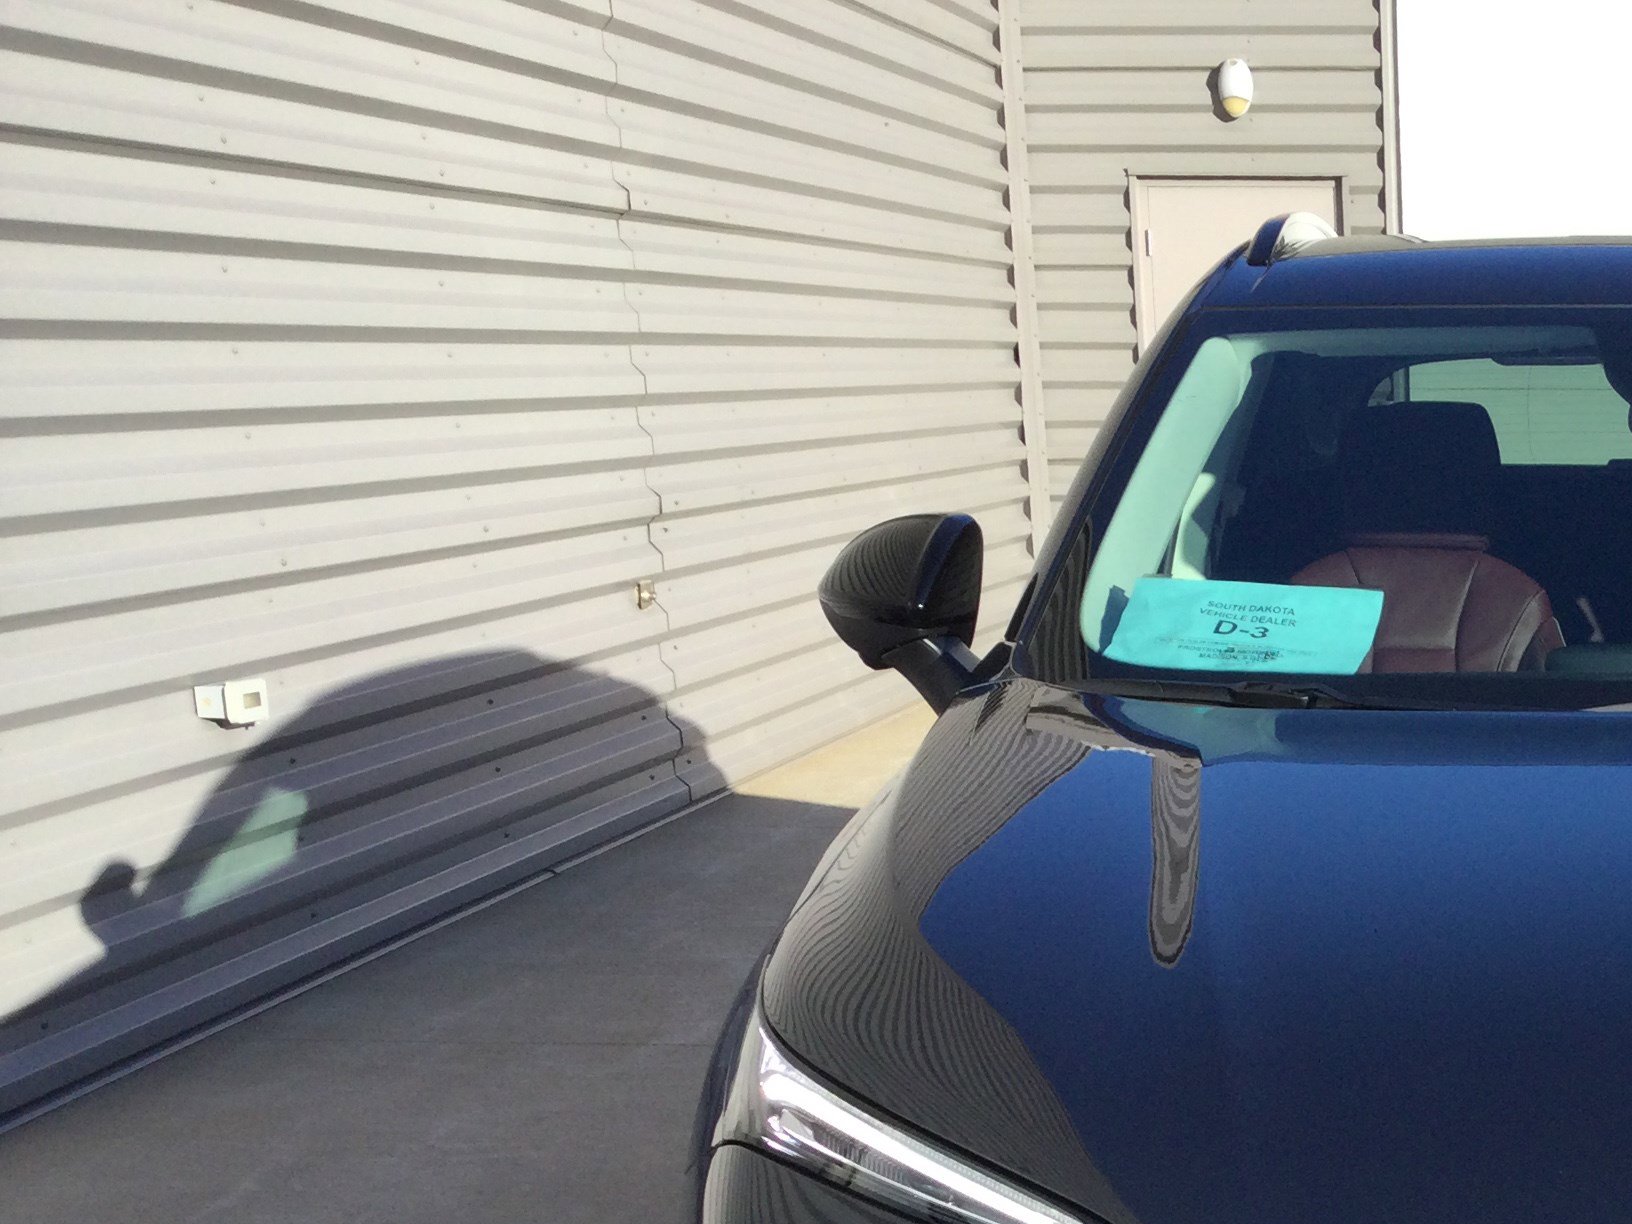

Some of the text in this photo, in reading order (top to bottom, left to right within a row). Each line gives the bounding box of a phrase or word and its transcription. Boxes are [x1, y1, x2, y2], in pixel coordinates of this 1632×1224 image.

[1207, 600, 1296, 615] SOUTH DAKOTA
[1200, 608, 1297, 627] VEHICLE DEALER
[1213, 619, 1269, 639] D-3
